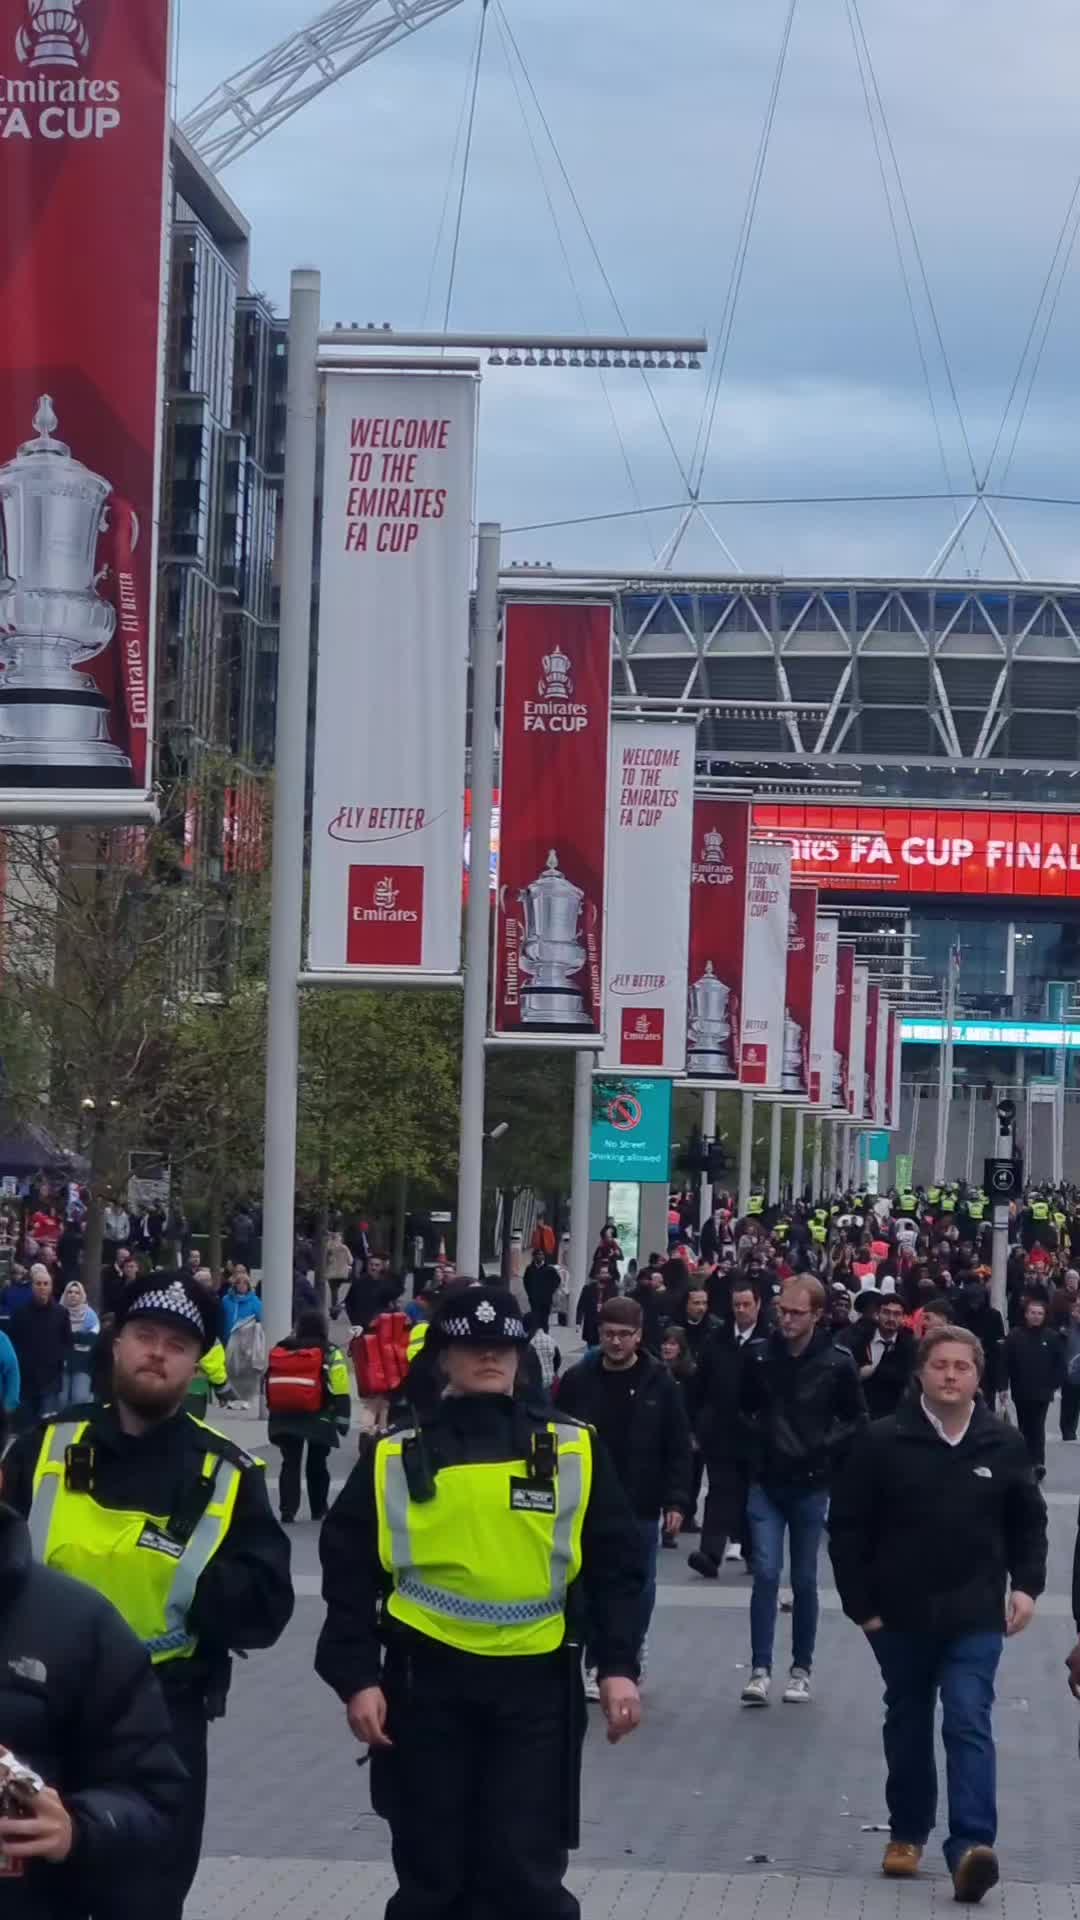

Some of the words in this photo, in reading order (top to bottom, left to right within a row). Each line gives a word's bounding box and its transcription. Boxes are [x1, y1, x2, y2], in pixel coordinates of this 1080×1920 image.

[0, 74, 120, 102] mirates
[39, 107, 121, 139] CUP
[350, 418, 451, 449] WELCOME
[348, 453, 373, 483] TO
[380, 453, 418, 483] THE
[346, 487, 448, 518] EMIRATES
[344, 522, 369, 551] FA
[376, 523, 419, 552] CUP
[126, 639, 149, 729] Emirates
[524, 700, 588, 716] Emirates
[523, 715, 546, 731] FA
[549, 716, 588, 732] CUP
[623, 748, 680, 767] WELCOME
[622, 768, 636, 786] TO
[640, 768, 662, 786] THE
[620, 788, 679, 807] EMIRATES
[337, 806, 364, 829] FLY
[368, 807, 425, 830] BETTER
[620, 808, 633, 826] FA
[637, 808, 663, 827] CUP
[850, 836, 894, 865] FA
[901, 836, 975, 867] CUP
[692, 873, 706, 884] FA
[707, 873, 734, 885] CUP
[748, 862, 781, 875] ELCOME
[353, 905, 418, 922] Emirates
[504, 951, 518, 1005] Emirates
[604, 1139, 618, 1149] No
